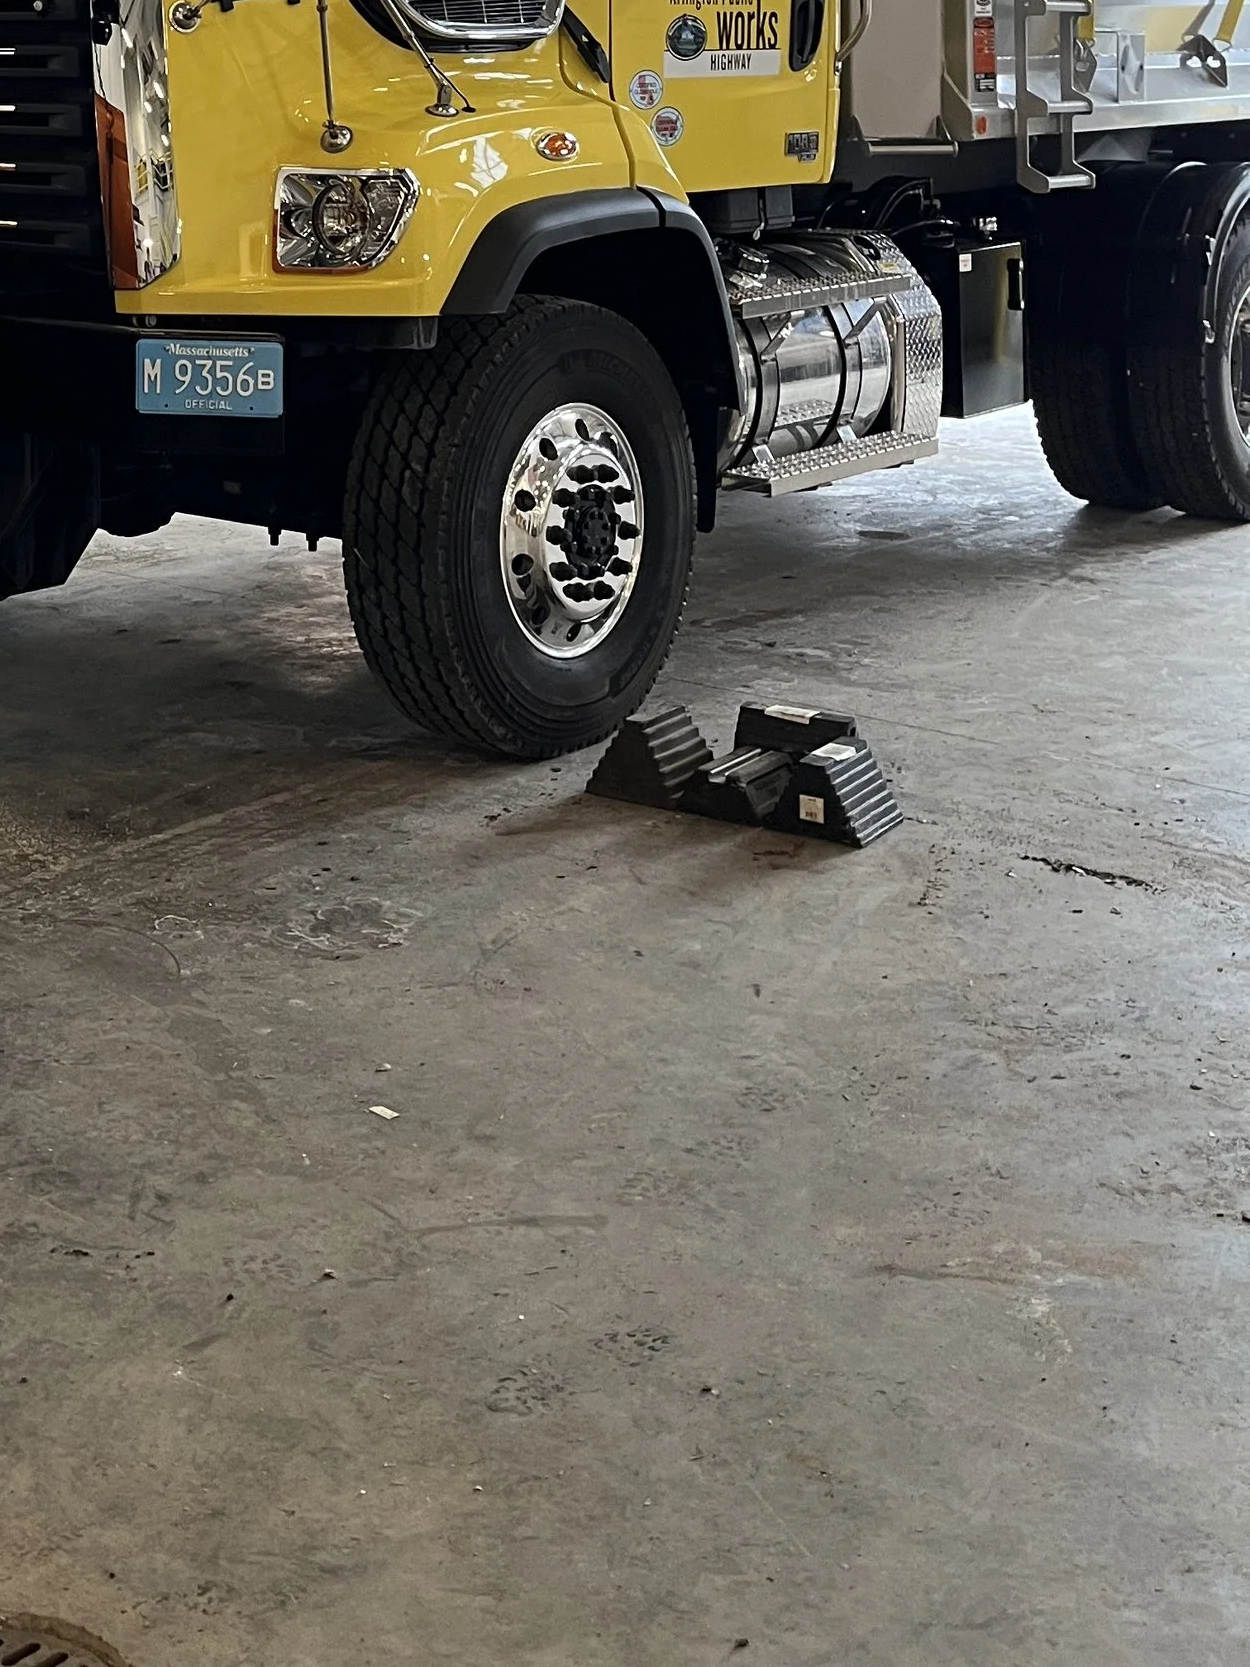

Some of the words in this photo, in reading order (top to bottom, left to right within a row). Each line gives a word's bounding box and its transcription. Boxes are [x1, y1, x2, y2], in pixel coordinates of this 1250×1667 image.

[710, 53, 751, 71] HIGHWAY
[167, 343, 249, 357] Massachusetts
[143, 358, 161, 394] M
[184, 399, 233, 411] OFFICIAL
